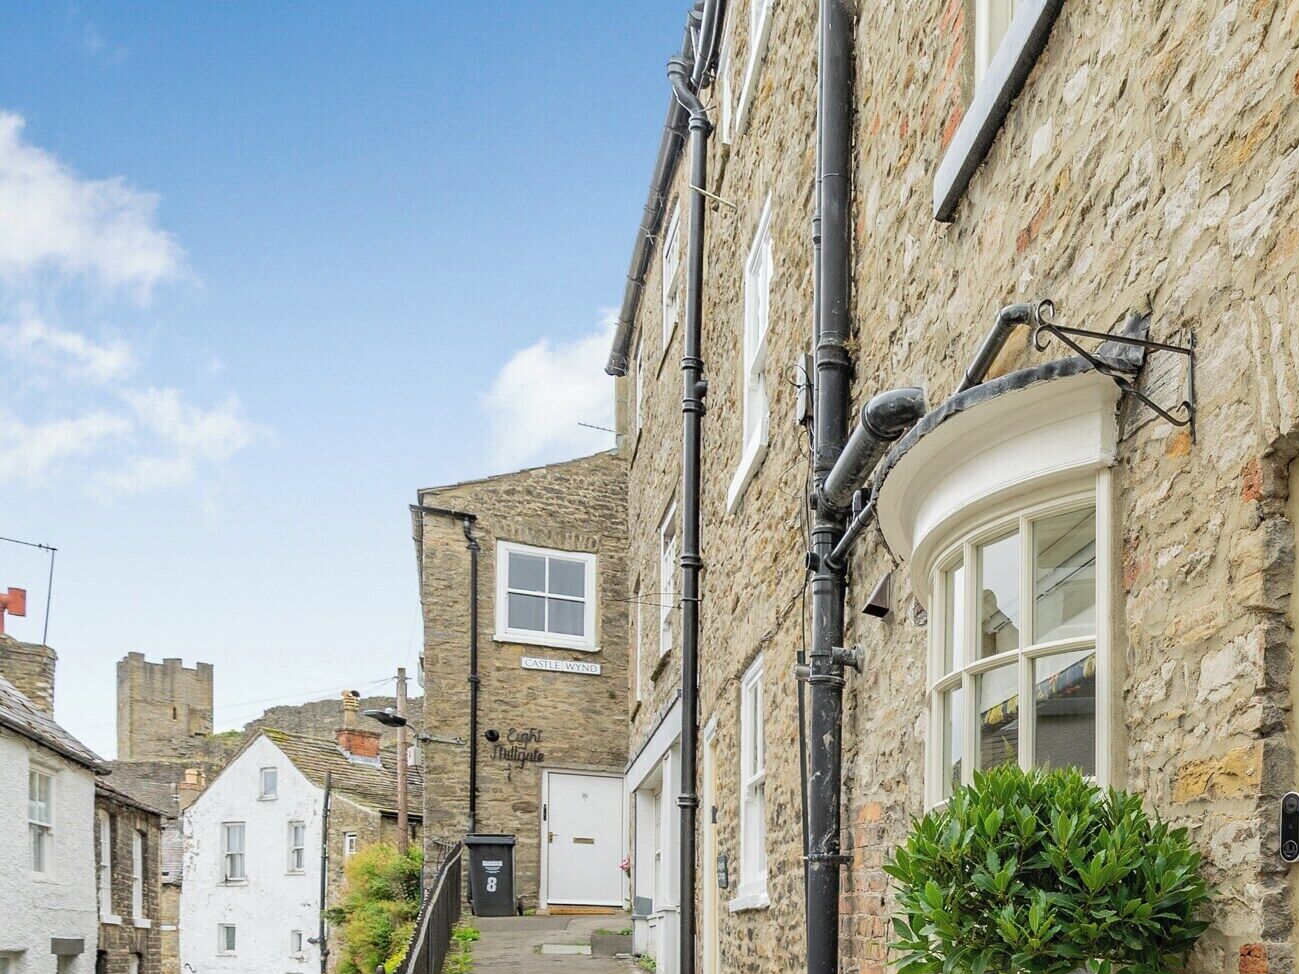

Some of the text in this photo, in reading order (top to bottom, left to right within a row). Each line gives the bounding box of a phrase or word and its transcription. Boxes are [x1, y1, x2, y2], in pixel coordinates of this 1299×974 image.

[524, 658, 598, 673] CASTLE WYND
[486, 876, 498, 893] 8
